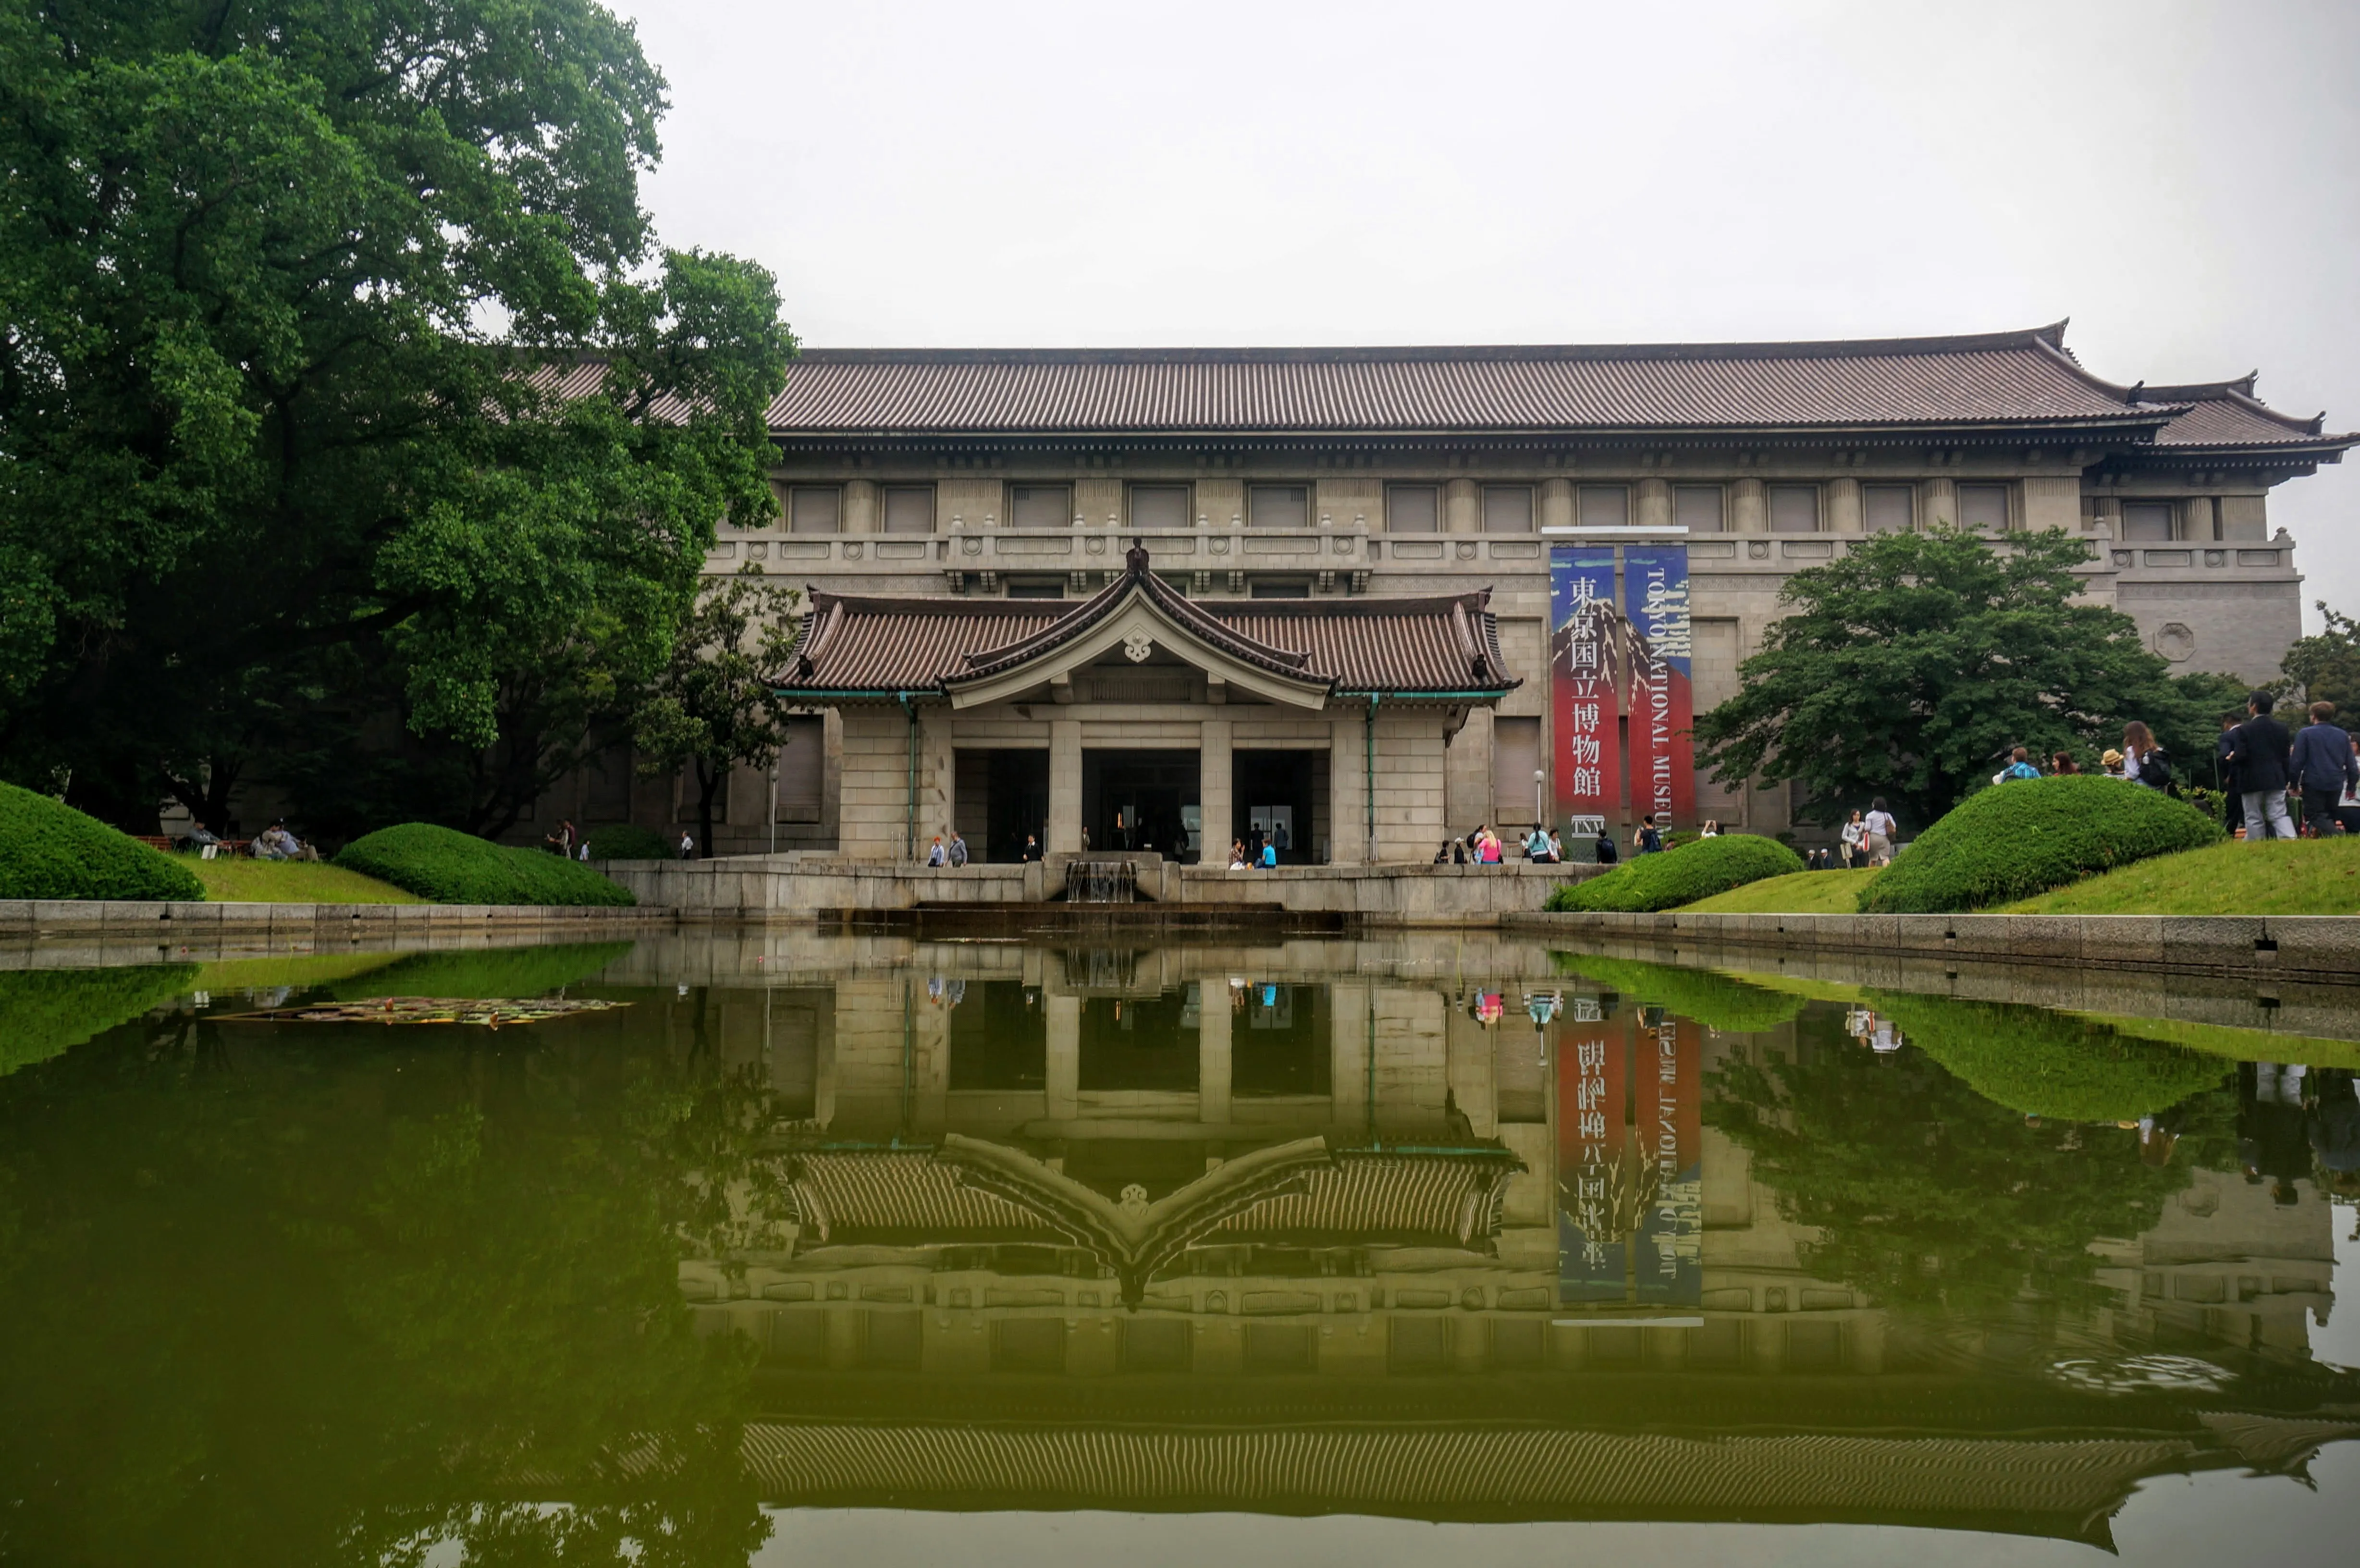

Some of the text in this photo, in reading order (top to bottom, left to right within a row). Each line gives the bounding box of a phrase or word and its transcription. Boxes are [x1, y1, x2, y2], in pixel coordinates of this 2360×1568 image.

[1647, 567, 1666, 637] TOKYO
[1569, 576, 1601, 796] 東京国立博物館
[1650, 643, 1669, 748] NATIONAL
[1571, 815, 1605, 837] TNM
